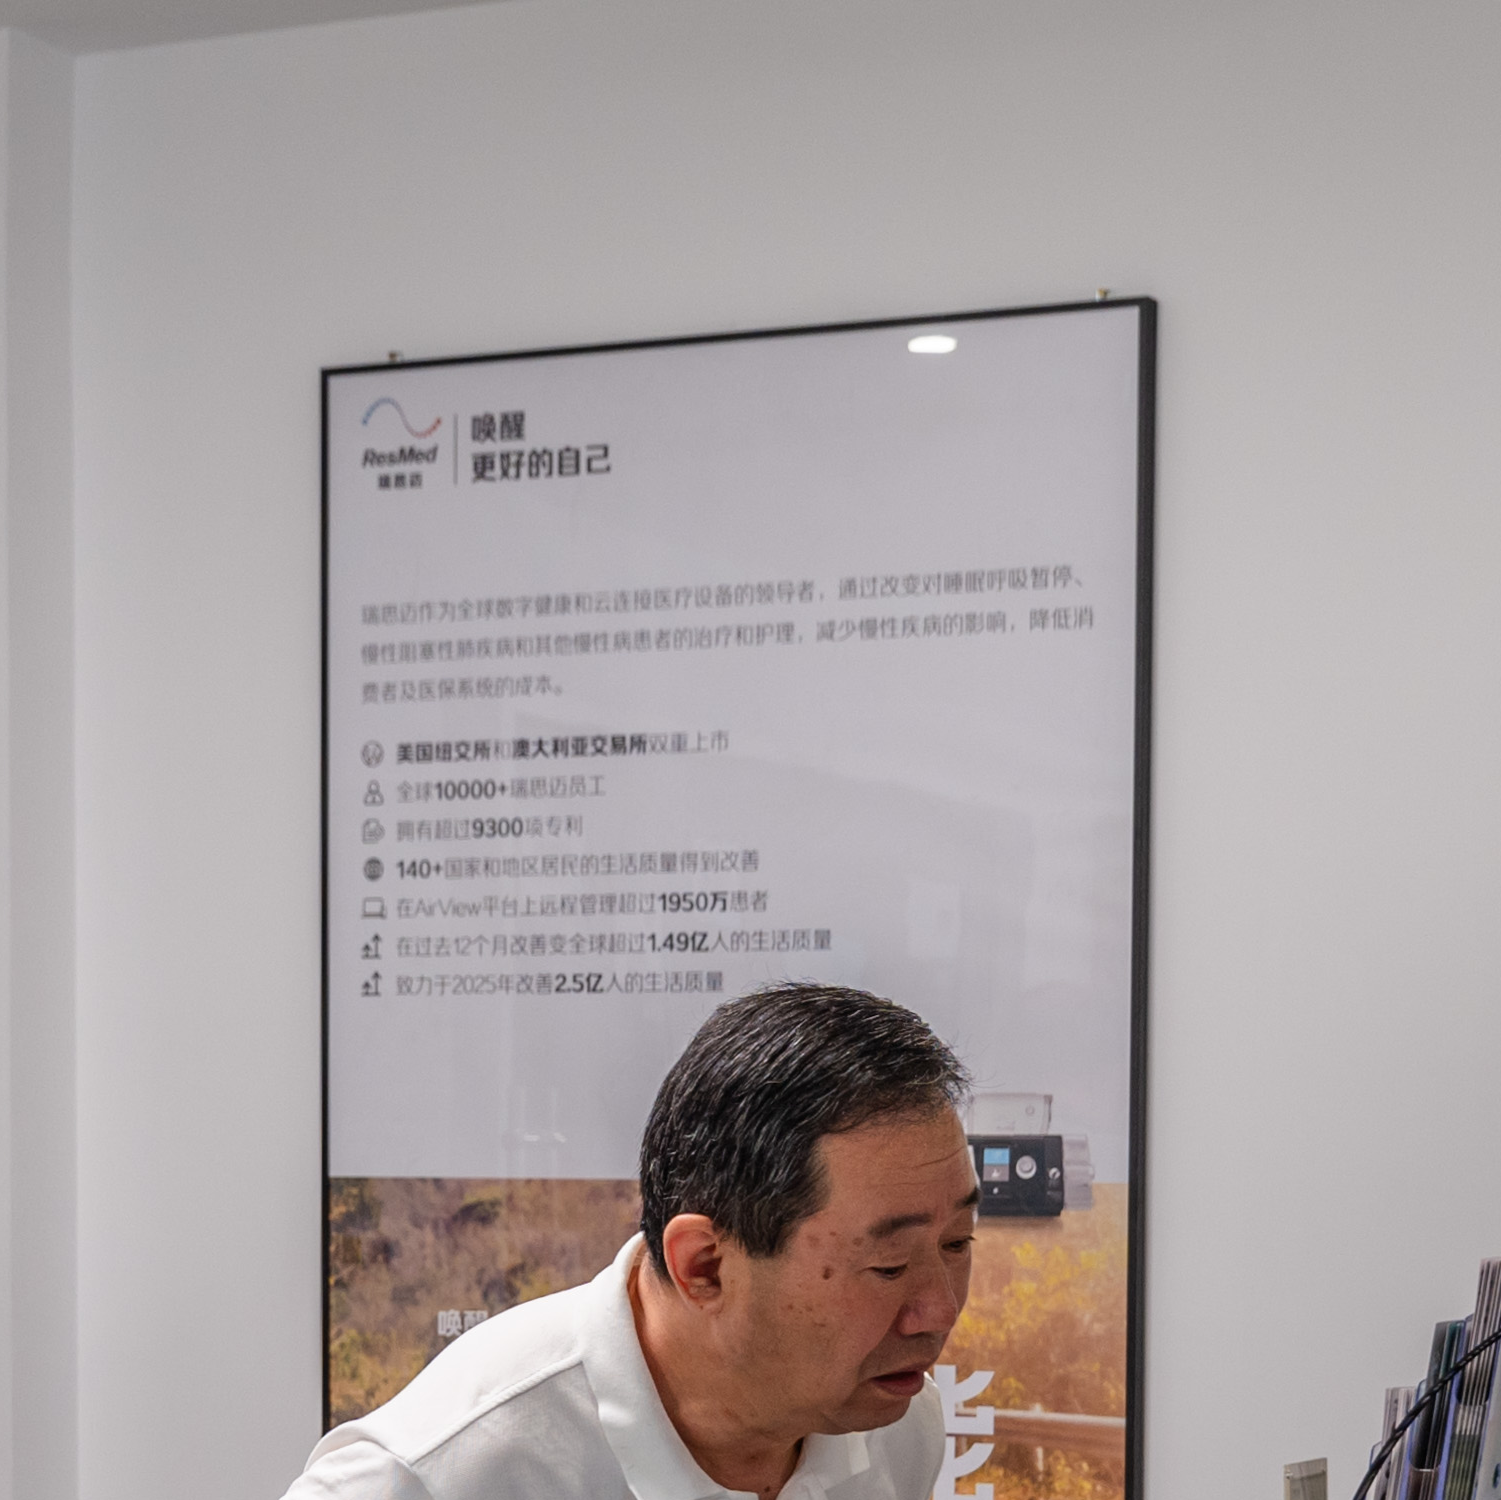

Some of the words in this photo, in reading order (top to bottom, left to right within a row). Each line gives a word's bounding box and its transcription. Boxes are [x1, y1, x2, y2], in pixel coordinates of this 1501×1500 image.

[470, 410, 526, 443] 唤醒
[362, 444, 438, 468] ResMed
[471, 444, 611, 483] 更好的自己
[397, 774, 606, 803] 全球10000+瑞思迈员工
[397, 815, 583, 841] 拥有超过9300项专利
